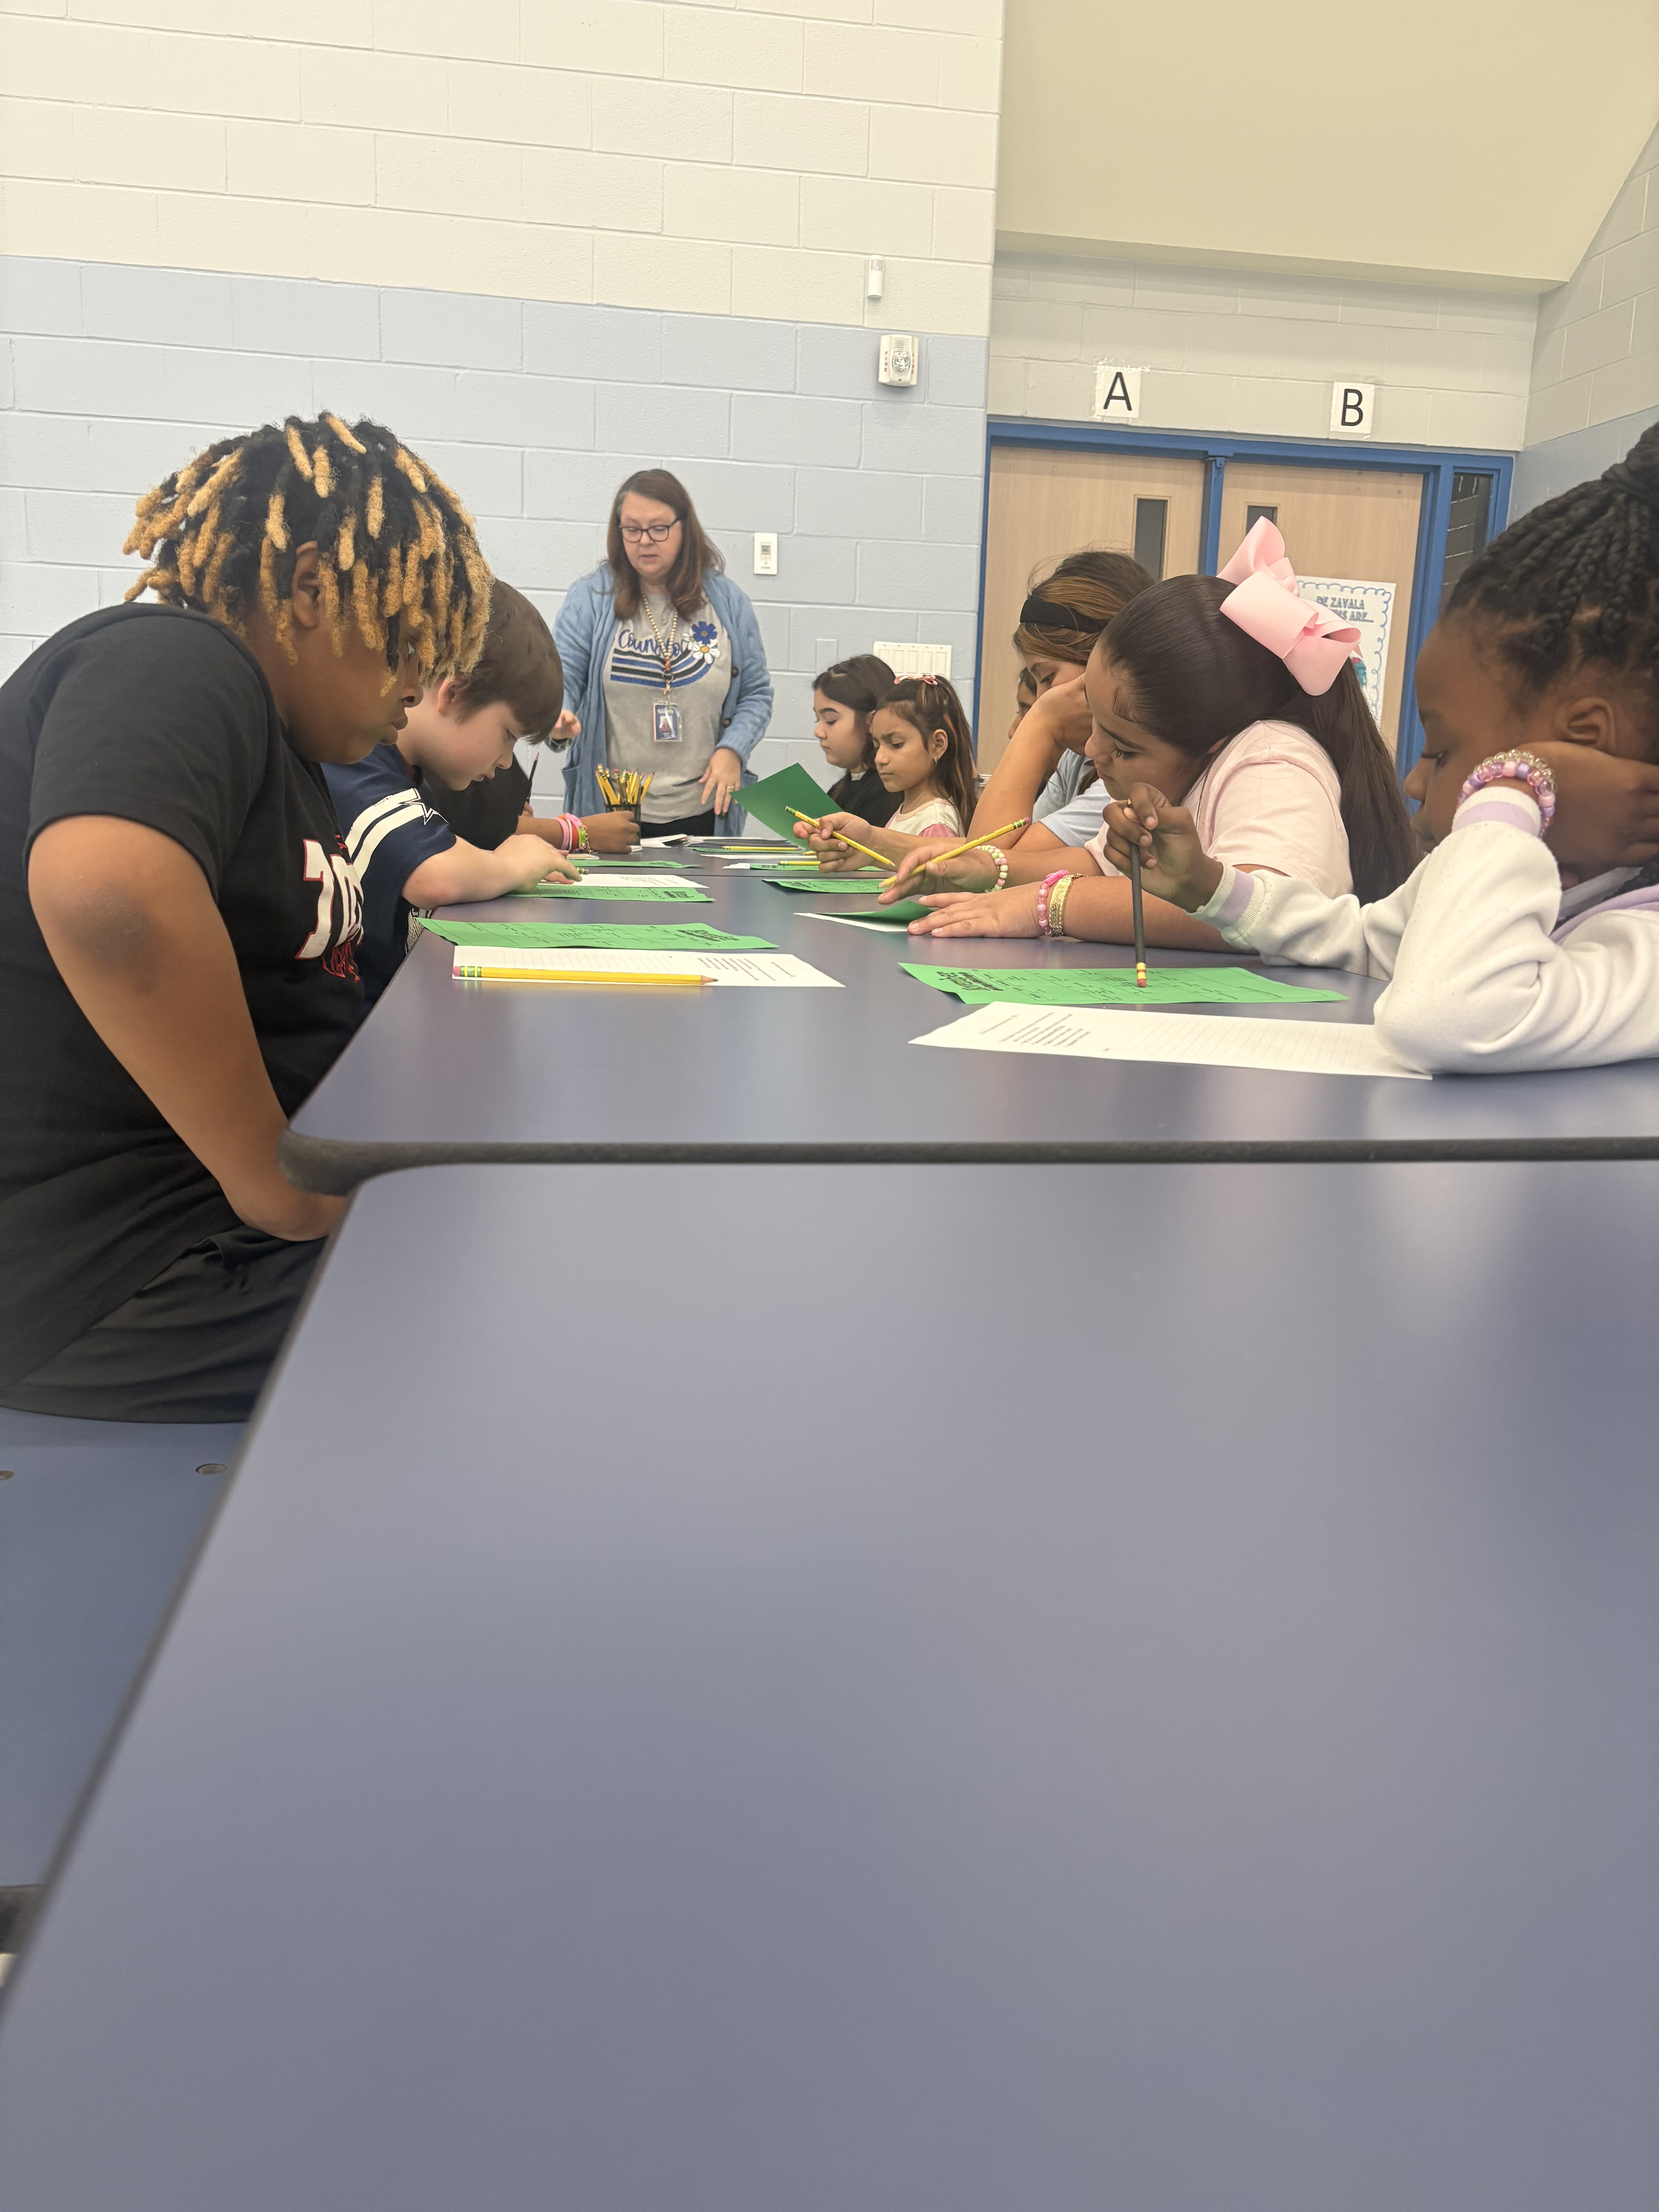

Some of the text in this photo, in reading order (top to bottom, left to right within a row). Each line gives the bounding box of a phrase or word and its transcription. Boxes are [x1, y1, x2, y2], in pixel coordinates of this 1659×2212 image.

[1103, 371, 1132, 411] A
[1341, 388, 1363, 426] B
[1329, 597, 1365, 610] ZAVALA
